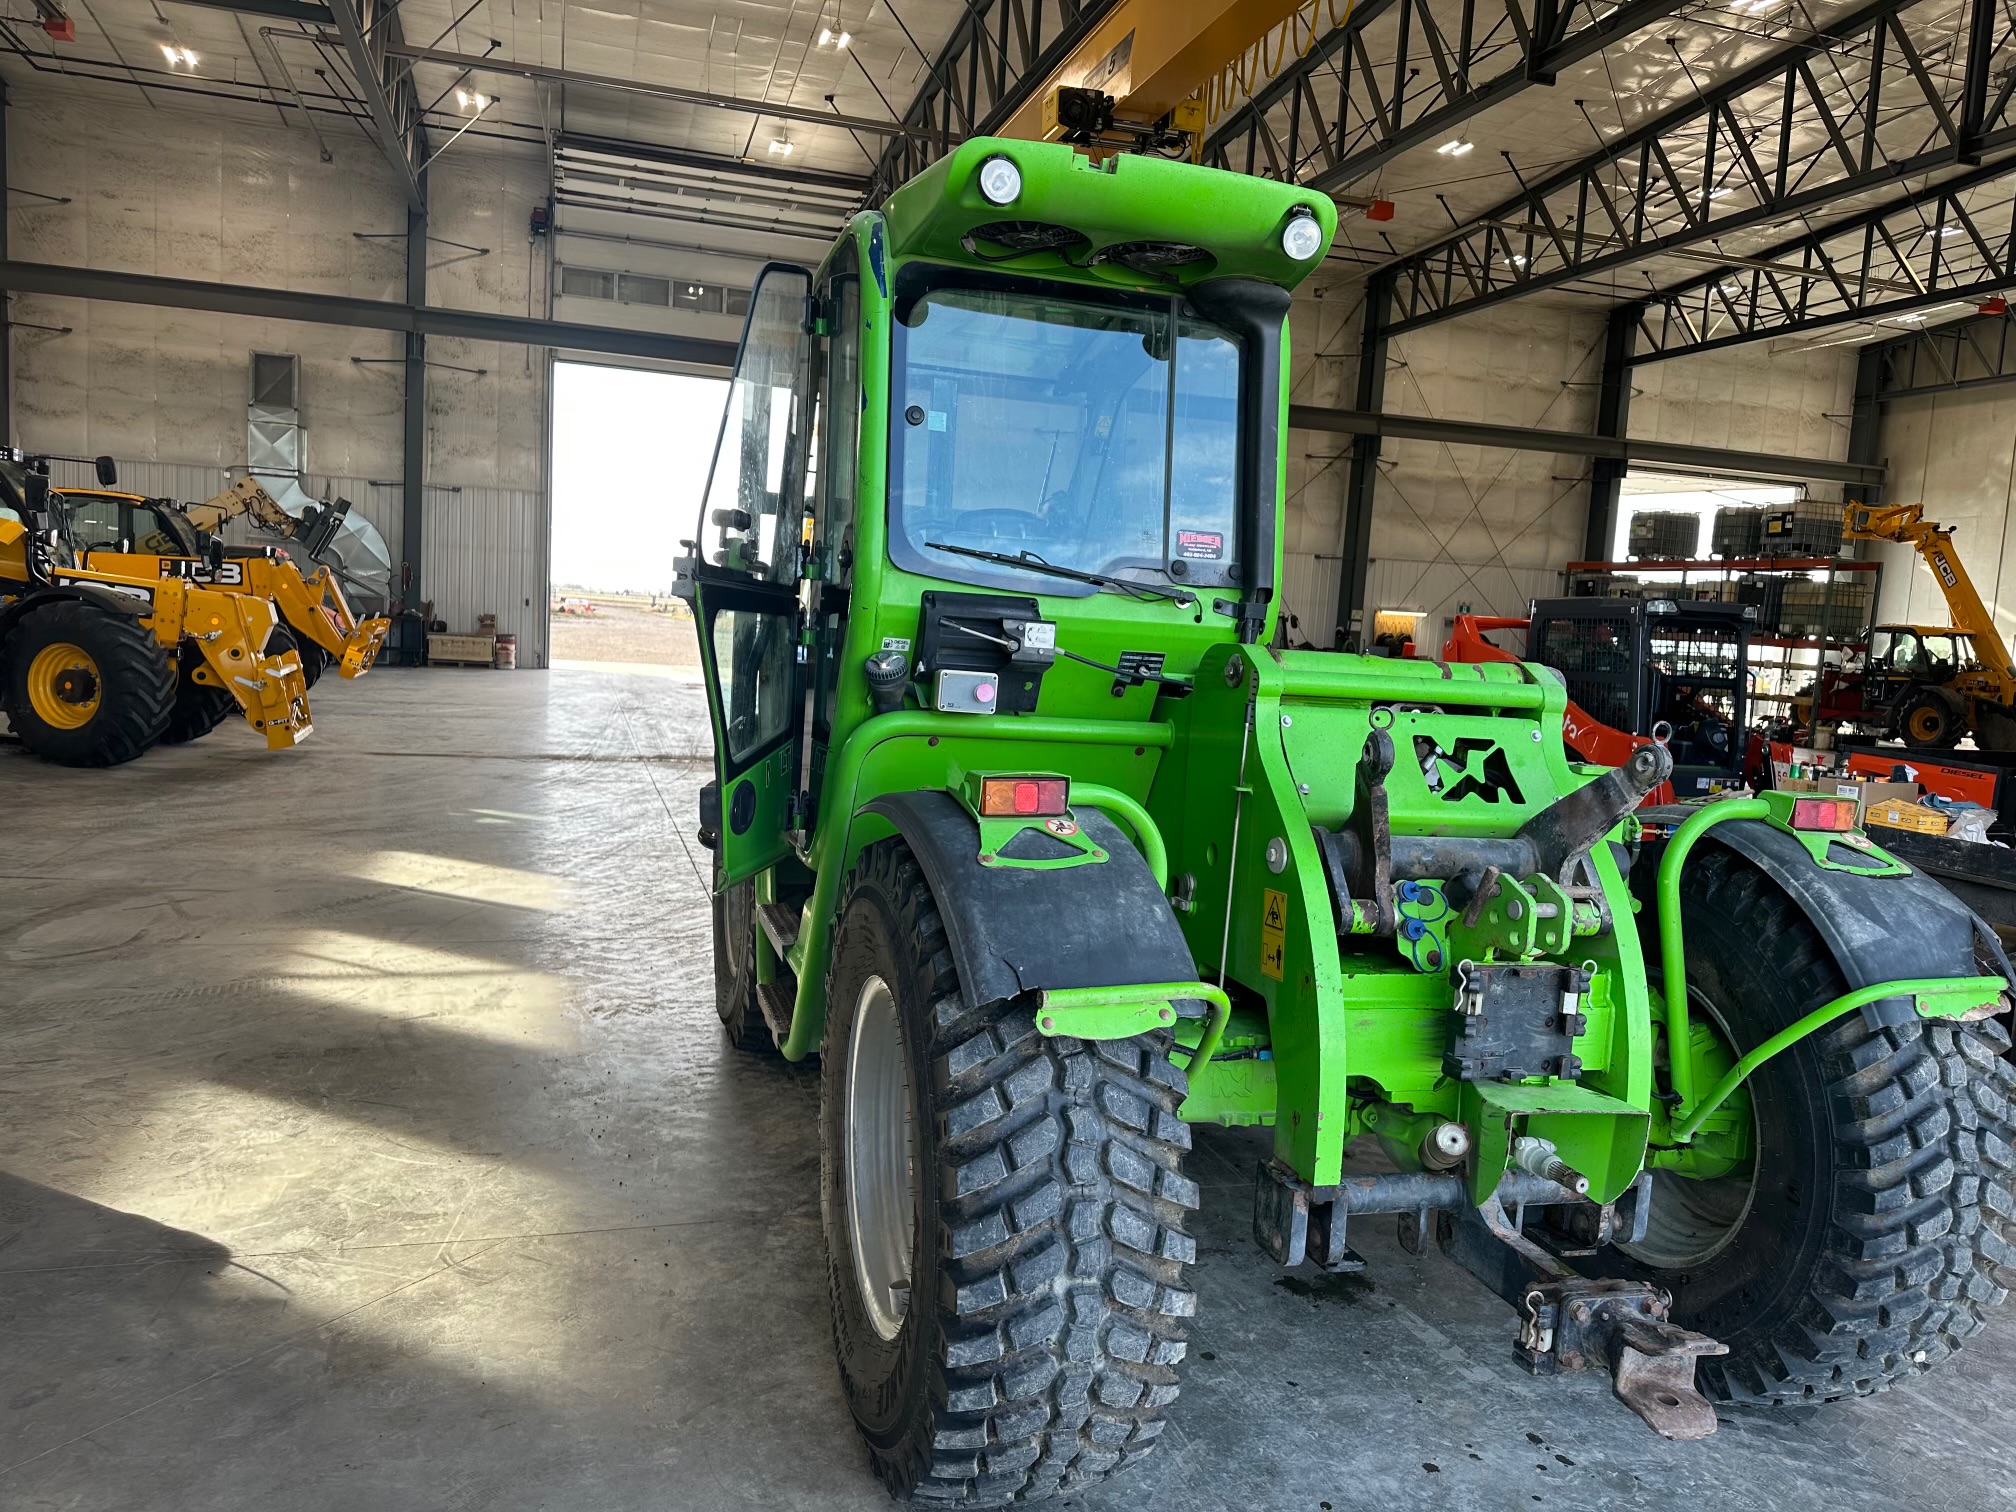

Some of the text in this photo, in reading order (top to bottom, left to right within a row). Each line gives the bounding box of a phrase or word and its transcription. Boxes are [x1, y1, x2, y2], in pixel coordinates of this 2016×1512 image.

[1107, 51, 1118, 76] 5
[1934, 556, 1957, 587] JCB
[1940, 767, 1987, 781] DIESEL
